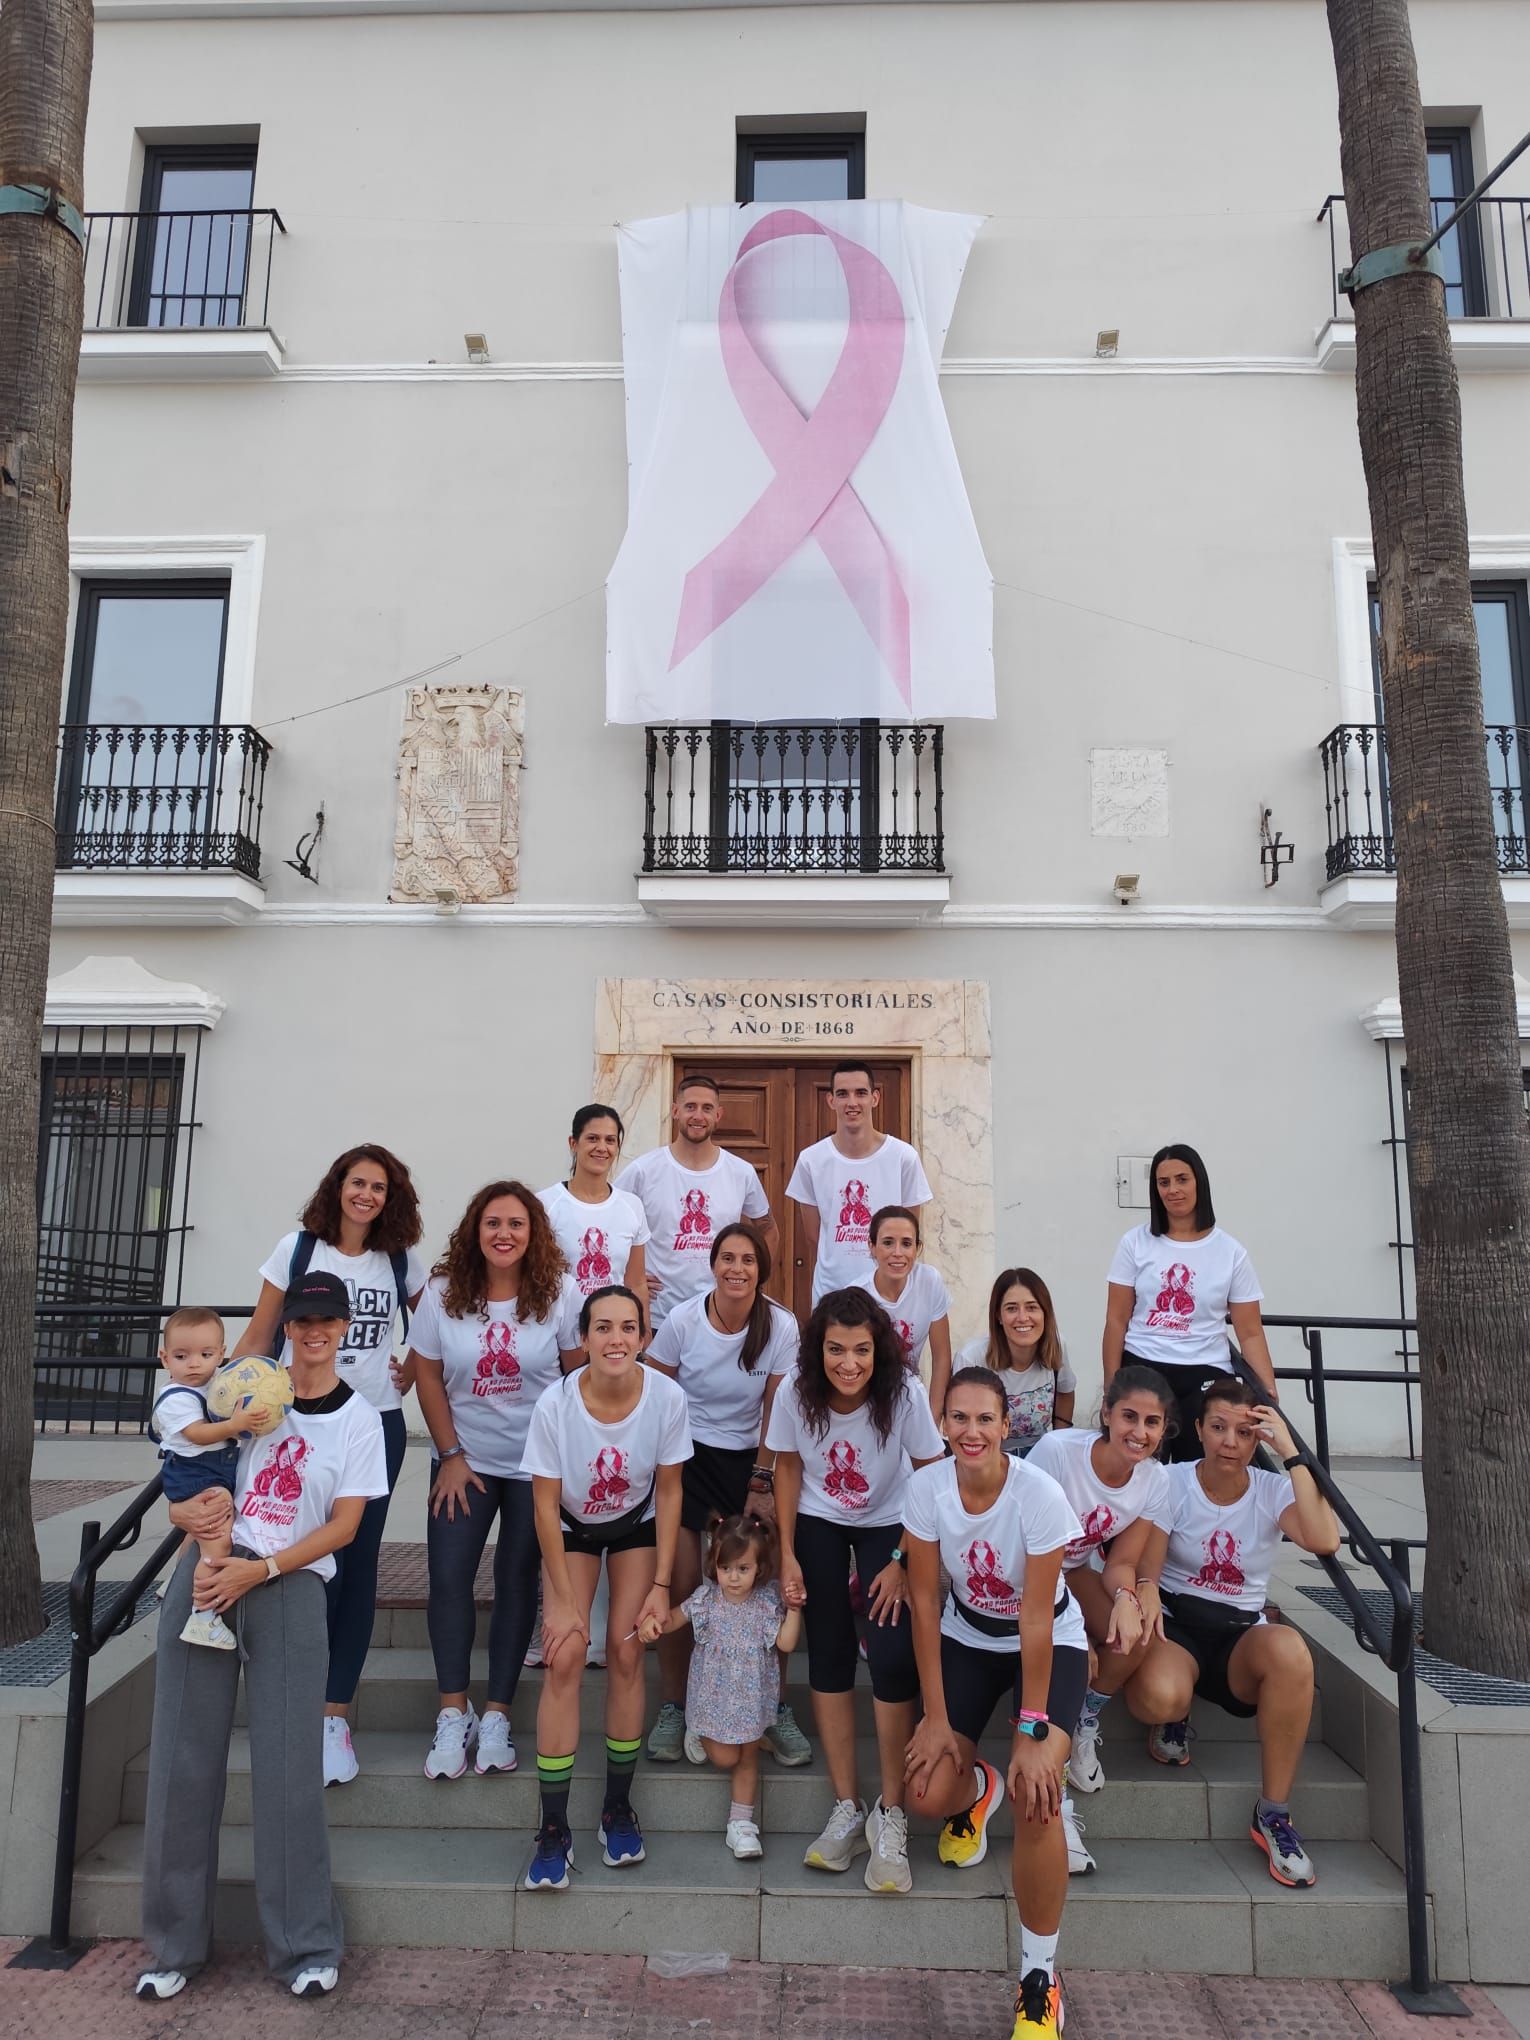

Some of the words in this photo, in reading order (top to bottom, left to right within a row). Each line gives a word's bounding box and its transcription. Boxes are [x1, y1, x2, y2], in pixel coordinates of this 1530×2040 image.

[653, 992, 727, 1007] CASAS
[740, 993, 934, 1008] CONSISTORIALES
[730, 1015, 771, 1034] AÑO
[781, 1021, 805, 1034] DE
[815, 1021, 854, 1034] 1868
